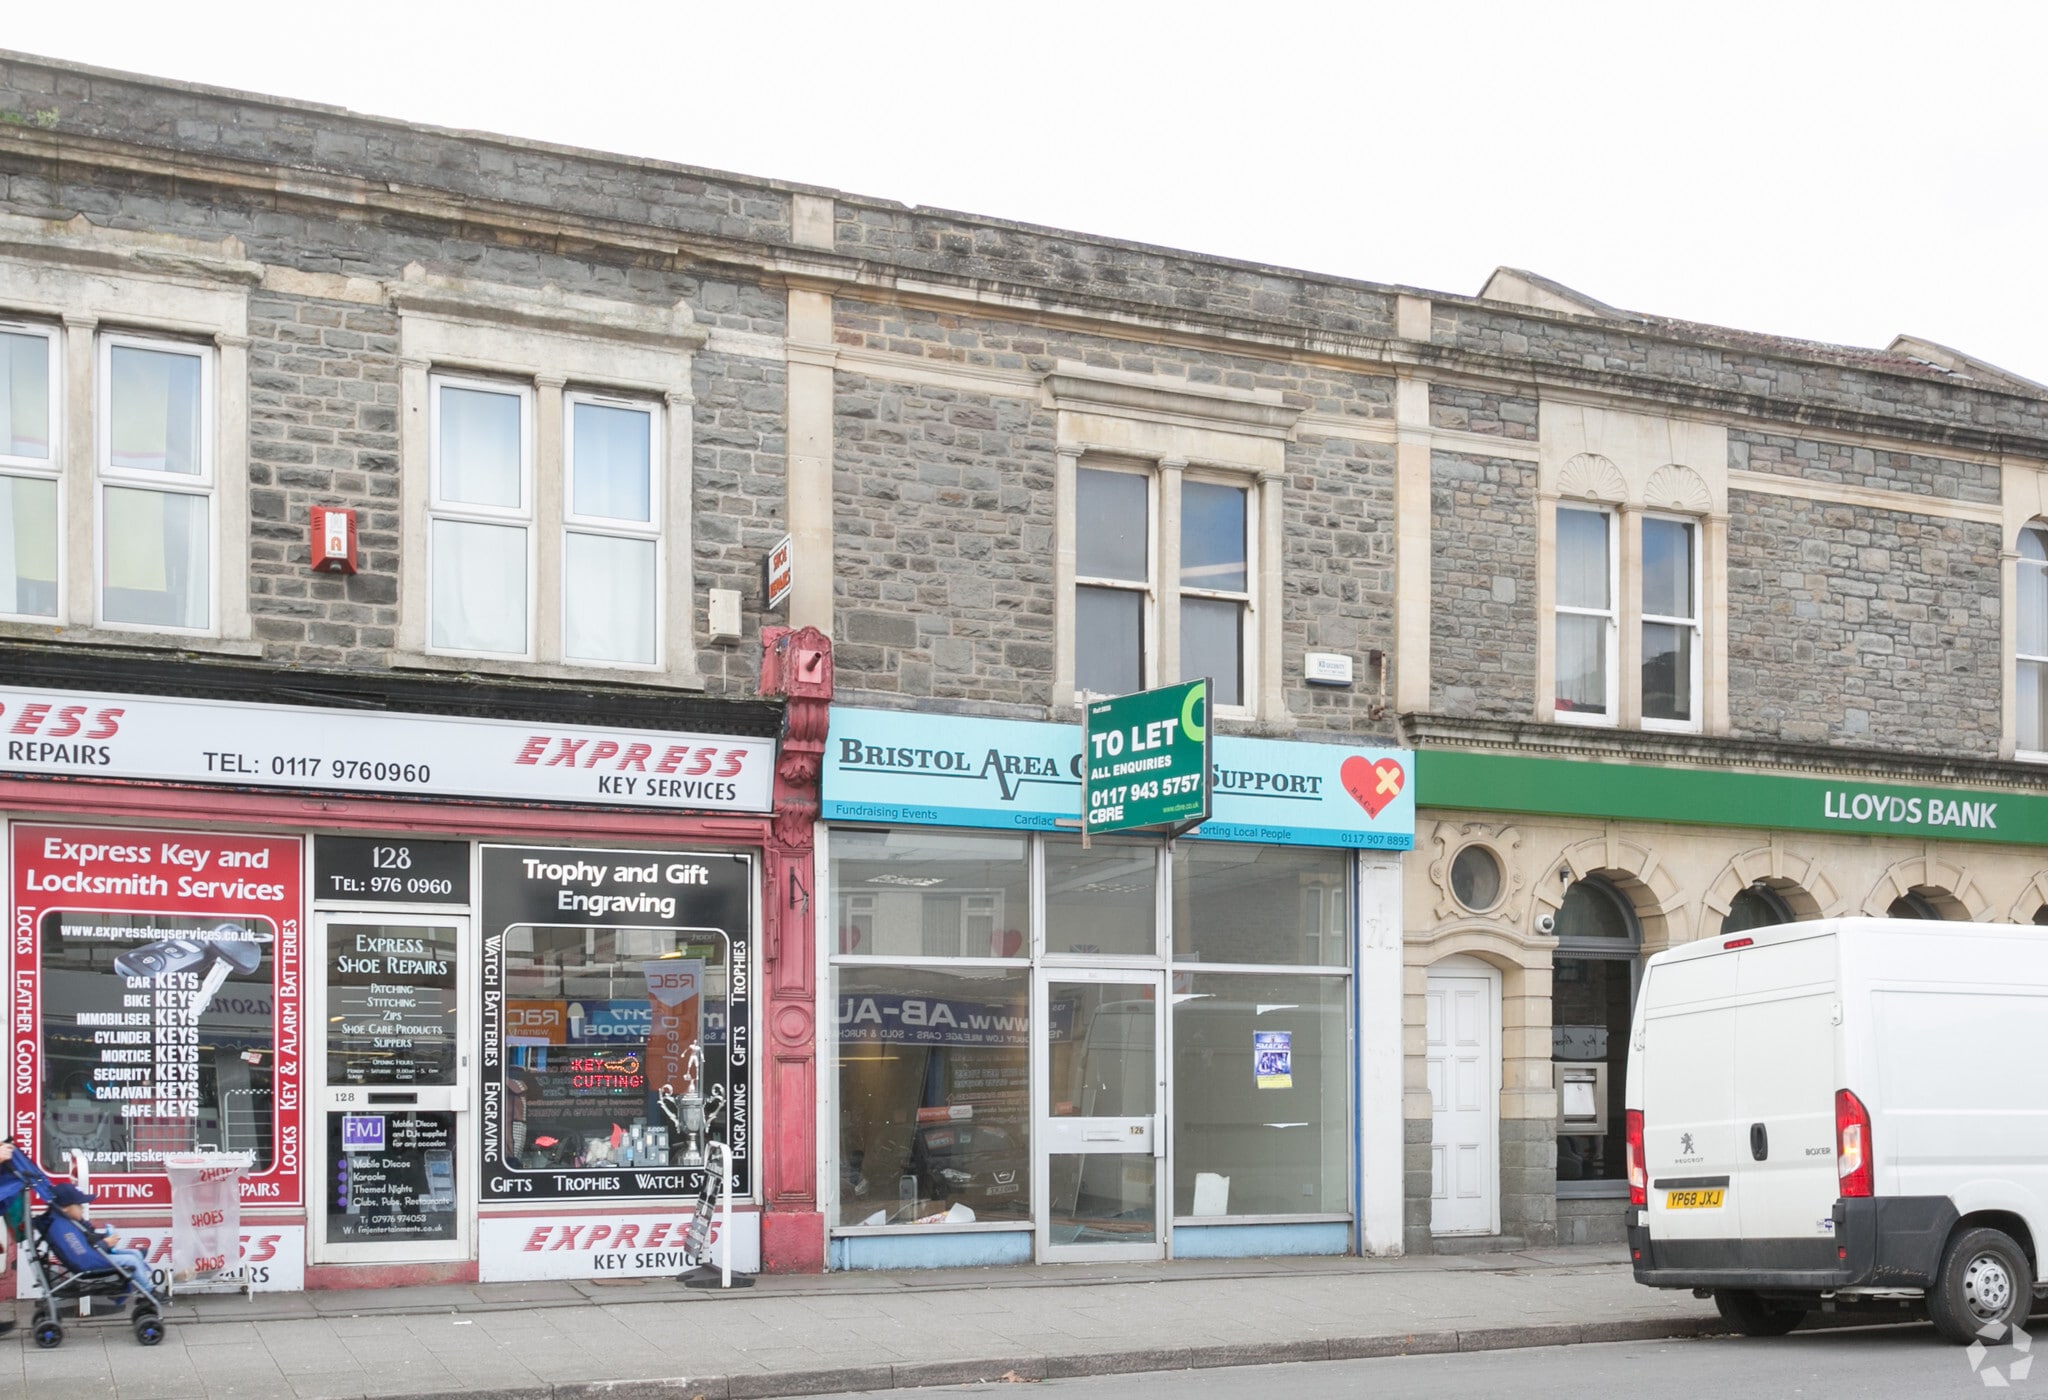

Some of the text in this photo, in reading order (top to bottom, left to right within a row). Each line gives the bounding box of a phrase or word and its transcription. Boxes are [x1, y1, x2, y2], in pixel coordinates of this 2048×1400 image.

[0, 702, 125, 739] ESS
[1092, 718, 1178, 759] TO LET
[9, 741, 111, 765] REPAIRS
[514, 736, 748, 777] EXPRESS
[203, 752, 431, 783] TEL: 0117 9760960
[839, 738, 970, 771] BRISTOL
[981, 749, 1059, 794] AREA
[1091, 766, 1111, 780] ALL
[1113, 755, 1172, 776] ENQUIRIES
[598, 776, 737, 801] KEY SERVICES
[1092, 774, 1200, 807] 0117 943 5757
[836, 804, 1053, 826] Fundraising Events Cardiac
[1089, 805, 1124, 824] CBRE
[1824, 791, 1998, 829] LLOYDS BANK
[1234, 827, 1258, 837] Local
[1261, 828, 1291, 840] People
[1341, 833, 1363, 844] 0117
[1367, 835, 1384, 845] 907
[1387, 835, 1410, 846] 8895
[44, 837, 270, 872] Express Key and
[373, 846, 412, 869] 128
[523, 858, 709, 887] Trophy and Gift
[26, 869, 285, 901] Locksmith Services
[371, 877, 402, 893] 976
[407, 878, 452, 894] 0960
[558, 890, 676, 919] Engraving
[61, 923, 256, 943] www.expresskeyservices.co.uk
[356, 934, 424, 953] EXPRESS
[337, 955, 447, 975] SHOE REPAIRS
[126, 972, 199, 989] CAR KEYS
[370, 983, 414, 994] PATCHING
[124, 990, 199, 1008] BIKE KEYS
[366, 997, 416, 1007] STITCHING
[76, 1008, 199, 1026] IMMOBILISER KEYS
[382, 1010, 402, 1021] ZIPS
[16, 905, 36, 1161] LOCKS LEATHER GOODS SLIPPE
[94, 1027, 199, 1044] CYLINDER KEYS
[342, 1023, 443, 1035] SHOE CARE PRODUCTS
[279, 919, 298, 1175] LOCKS KEY & ALARM BATTERIES
[373, 1038, 412, 1048] SLIPPERS
[484, 934, 501, 1163] WATCH BATTERIES ENGRAVING
[731, 939, 746, 1160] ENGRAVING GIFTS TROPHIES
[101, 1045, 199, 1063] MORTICE KEYS
[93, 1063, 199, 1081] SECURITY KEYS
[573, 1058, 604, 1072] KEY
[96, 1082, 199, 1099] CARAVAN KEYS
[573, 1075, 641, 1088] CUTTING
[335, 1093, 355, 1102] 128
[121, 1100, 199, 1118] SAFE KEYS
[346, 1122, 381, 1138] FMJ
[1130, 1126, 1144, 1135] 126
[1805, 1147, 1831, 1155] BOXER
[89, 1182, 280, 1198] UTTING PAIRS
[490, 1176, 533, 1193] GIFTS
[553, 1175, 620, 1192] TROPHIES
[635, 1173, 684, 1189] WATCH
[1671, 1191, 1720, 1206] YP68 JXJ
[191, 1209, 224, 1227] SHOES
[594, 1251, 713, 1270] KEY SERVICE
